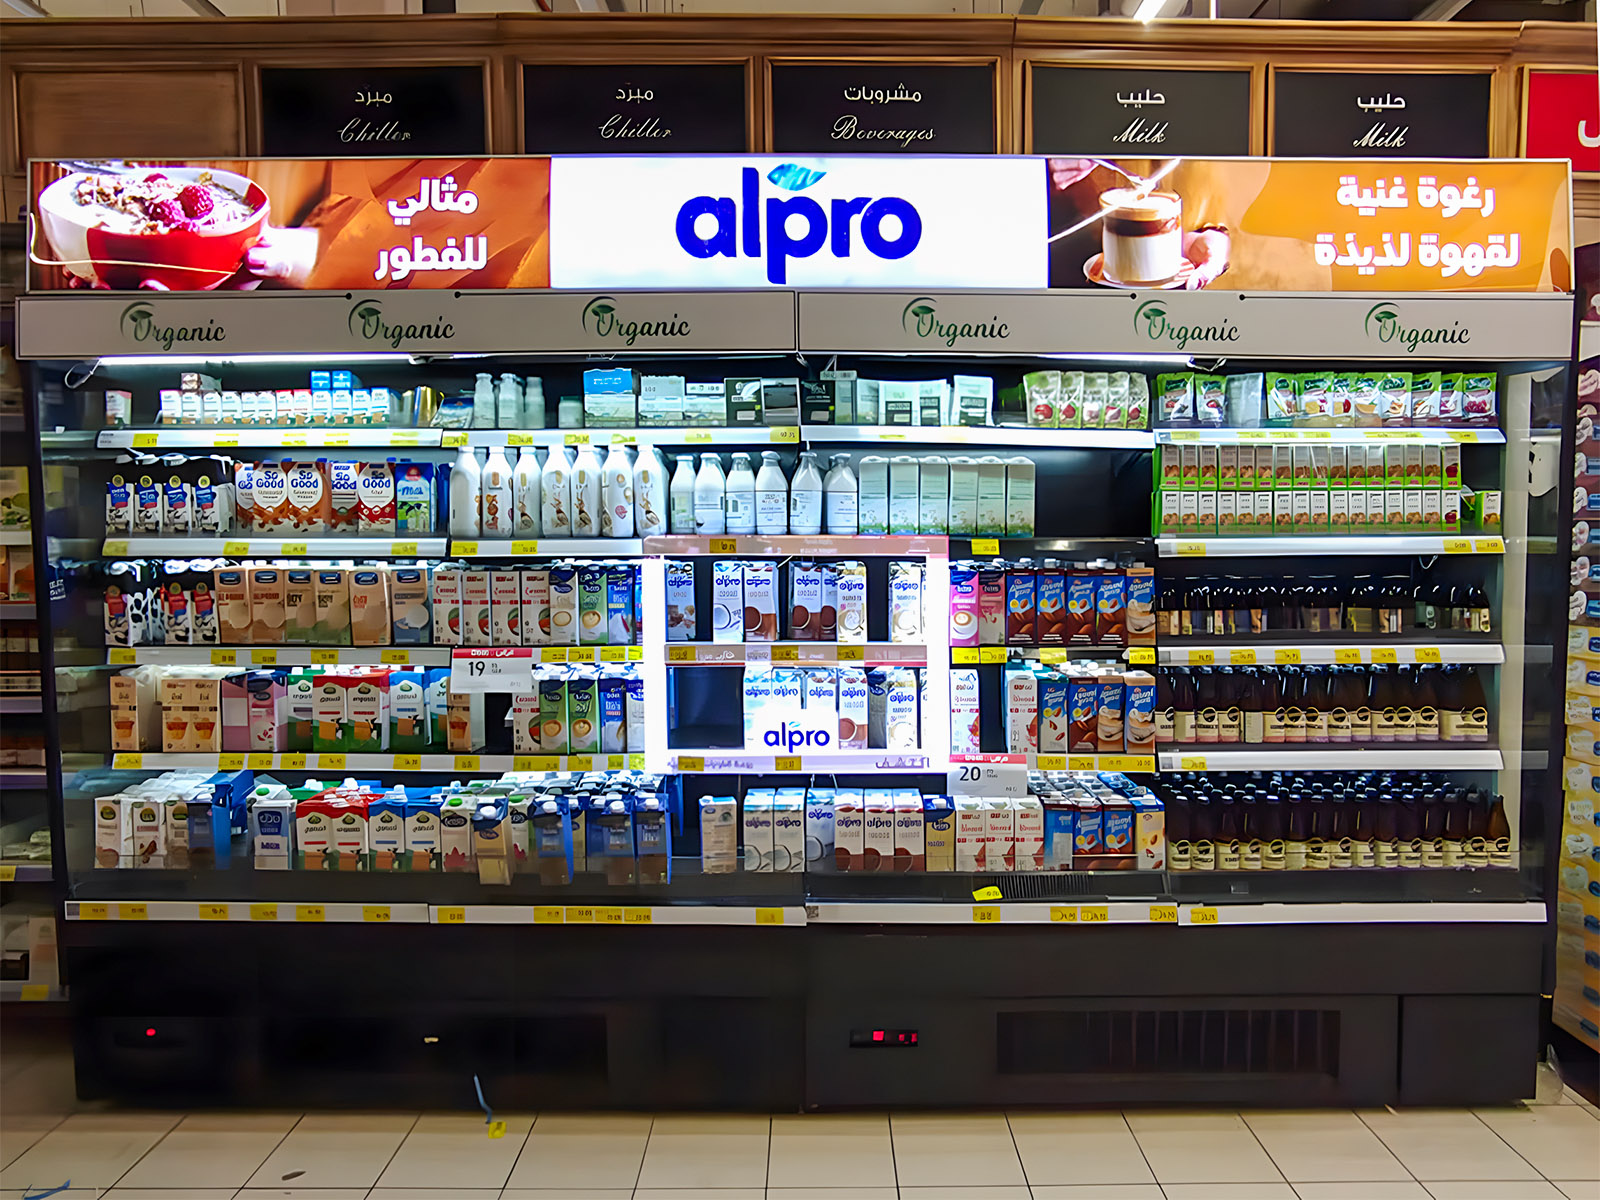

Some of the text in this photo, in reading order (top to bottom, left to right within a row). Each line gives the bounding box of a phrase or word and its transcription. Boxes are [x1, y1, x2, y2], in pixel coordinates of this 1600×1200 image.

[844, 82, 922, 105] مشروبات
[1116, 89, 1166, 108] حليب
[1357, 92, 1406, 113] حليب
[1112, 116, 1170, 144] Milk
[1352, 121, 1409, 149] Milk
[386, 174, 480, 227] مثالي
[1336, 174, 1496, 219] رغوة غنية
[675, 166, 923, 285] alpro
[373, 235, 488, 281] للفطور
[1314, 231, 1521, 278] لقهوة لذيذة
[131, 312, 226, 351] Organic
[360, 308, 455, 349] Organic
[595, 305, 691, 346] Organic
[915, 308, 1010, 347] Organic
[1147, 310, 1241, 350] Organic
[1377, 316, 1471, 353] Organic
[256, 478, 284, 489] Good
[291, 478, 319, 489] Good
[468, 660, 486, 677] 19
[763, 721, 831, 754] alpro
[959, 765, 981, 782] 20
